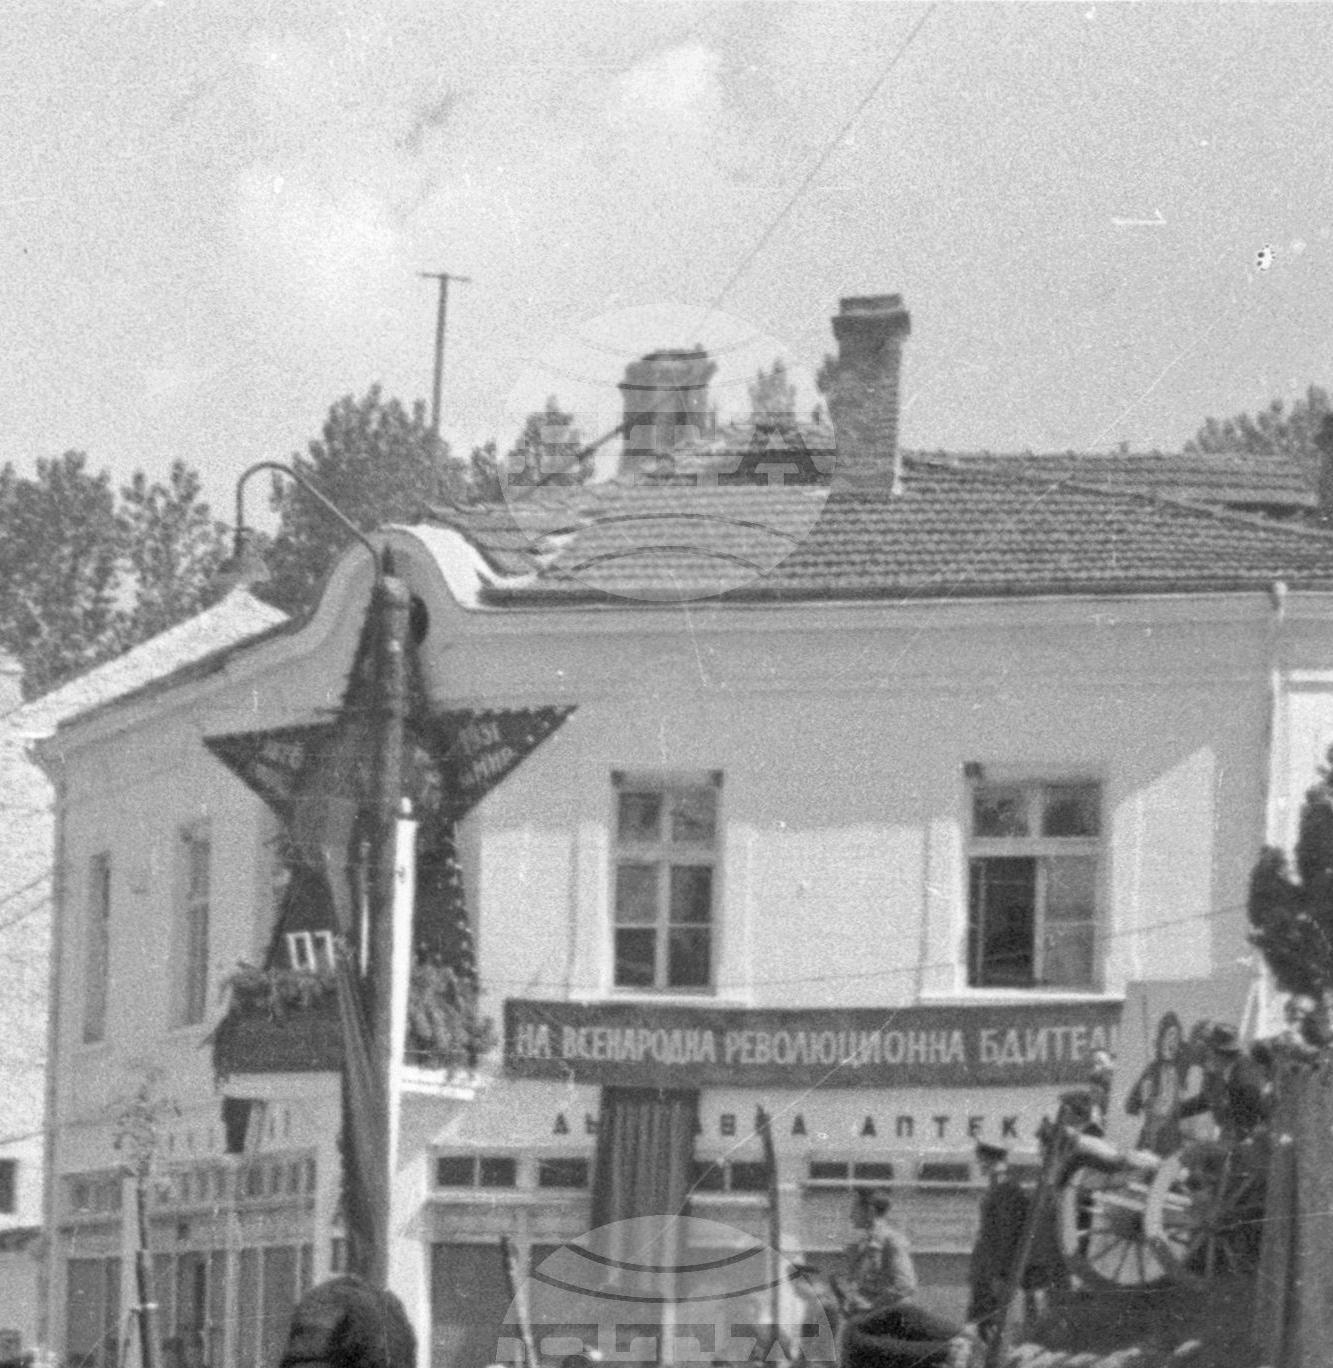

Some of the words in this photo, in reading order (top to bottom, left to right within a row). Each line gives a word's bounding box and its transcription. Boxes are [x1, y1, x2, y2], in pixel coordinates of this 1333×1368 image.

[515, 1022, 552, 1059] НА
[561, 1024, 717, 1065] ВСЕНАРОДНА
[724, 1027, 966, 1067] РЕВОЛЮЦИОННА
